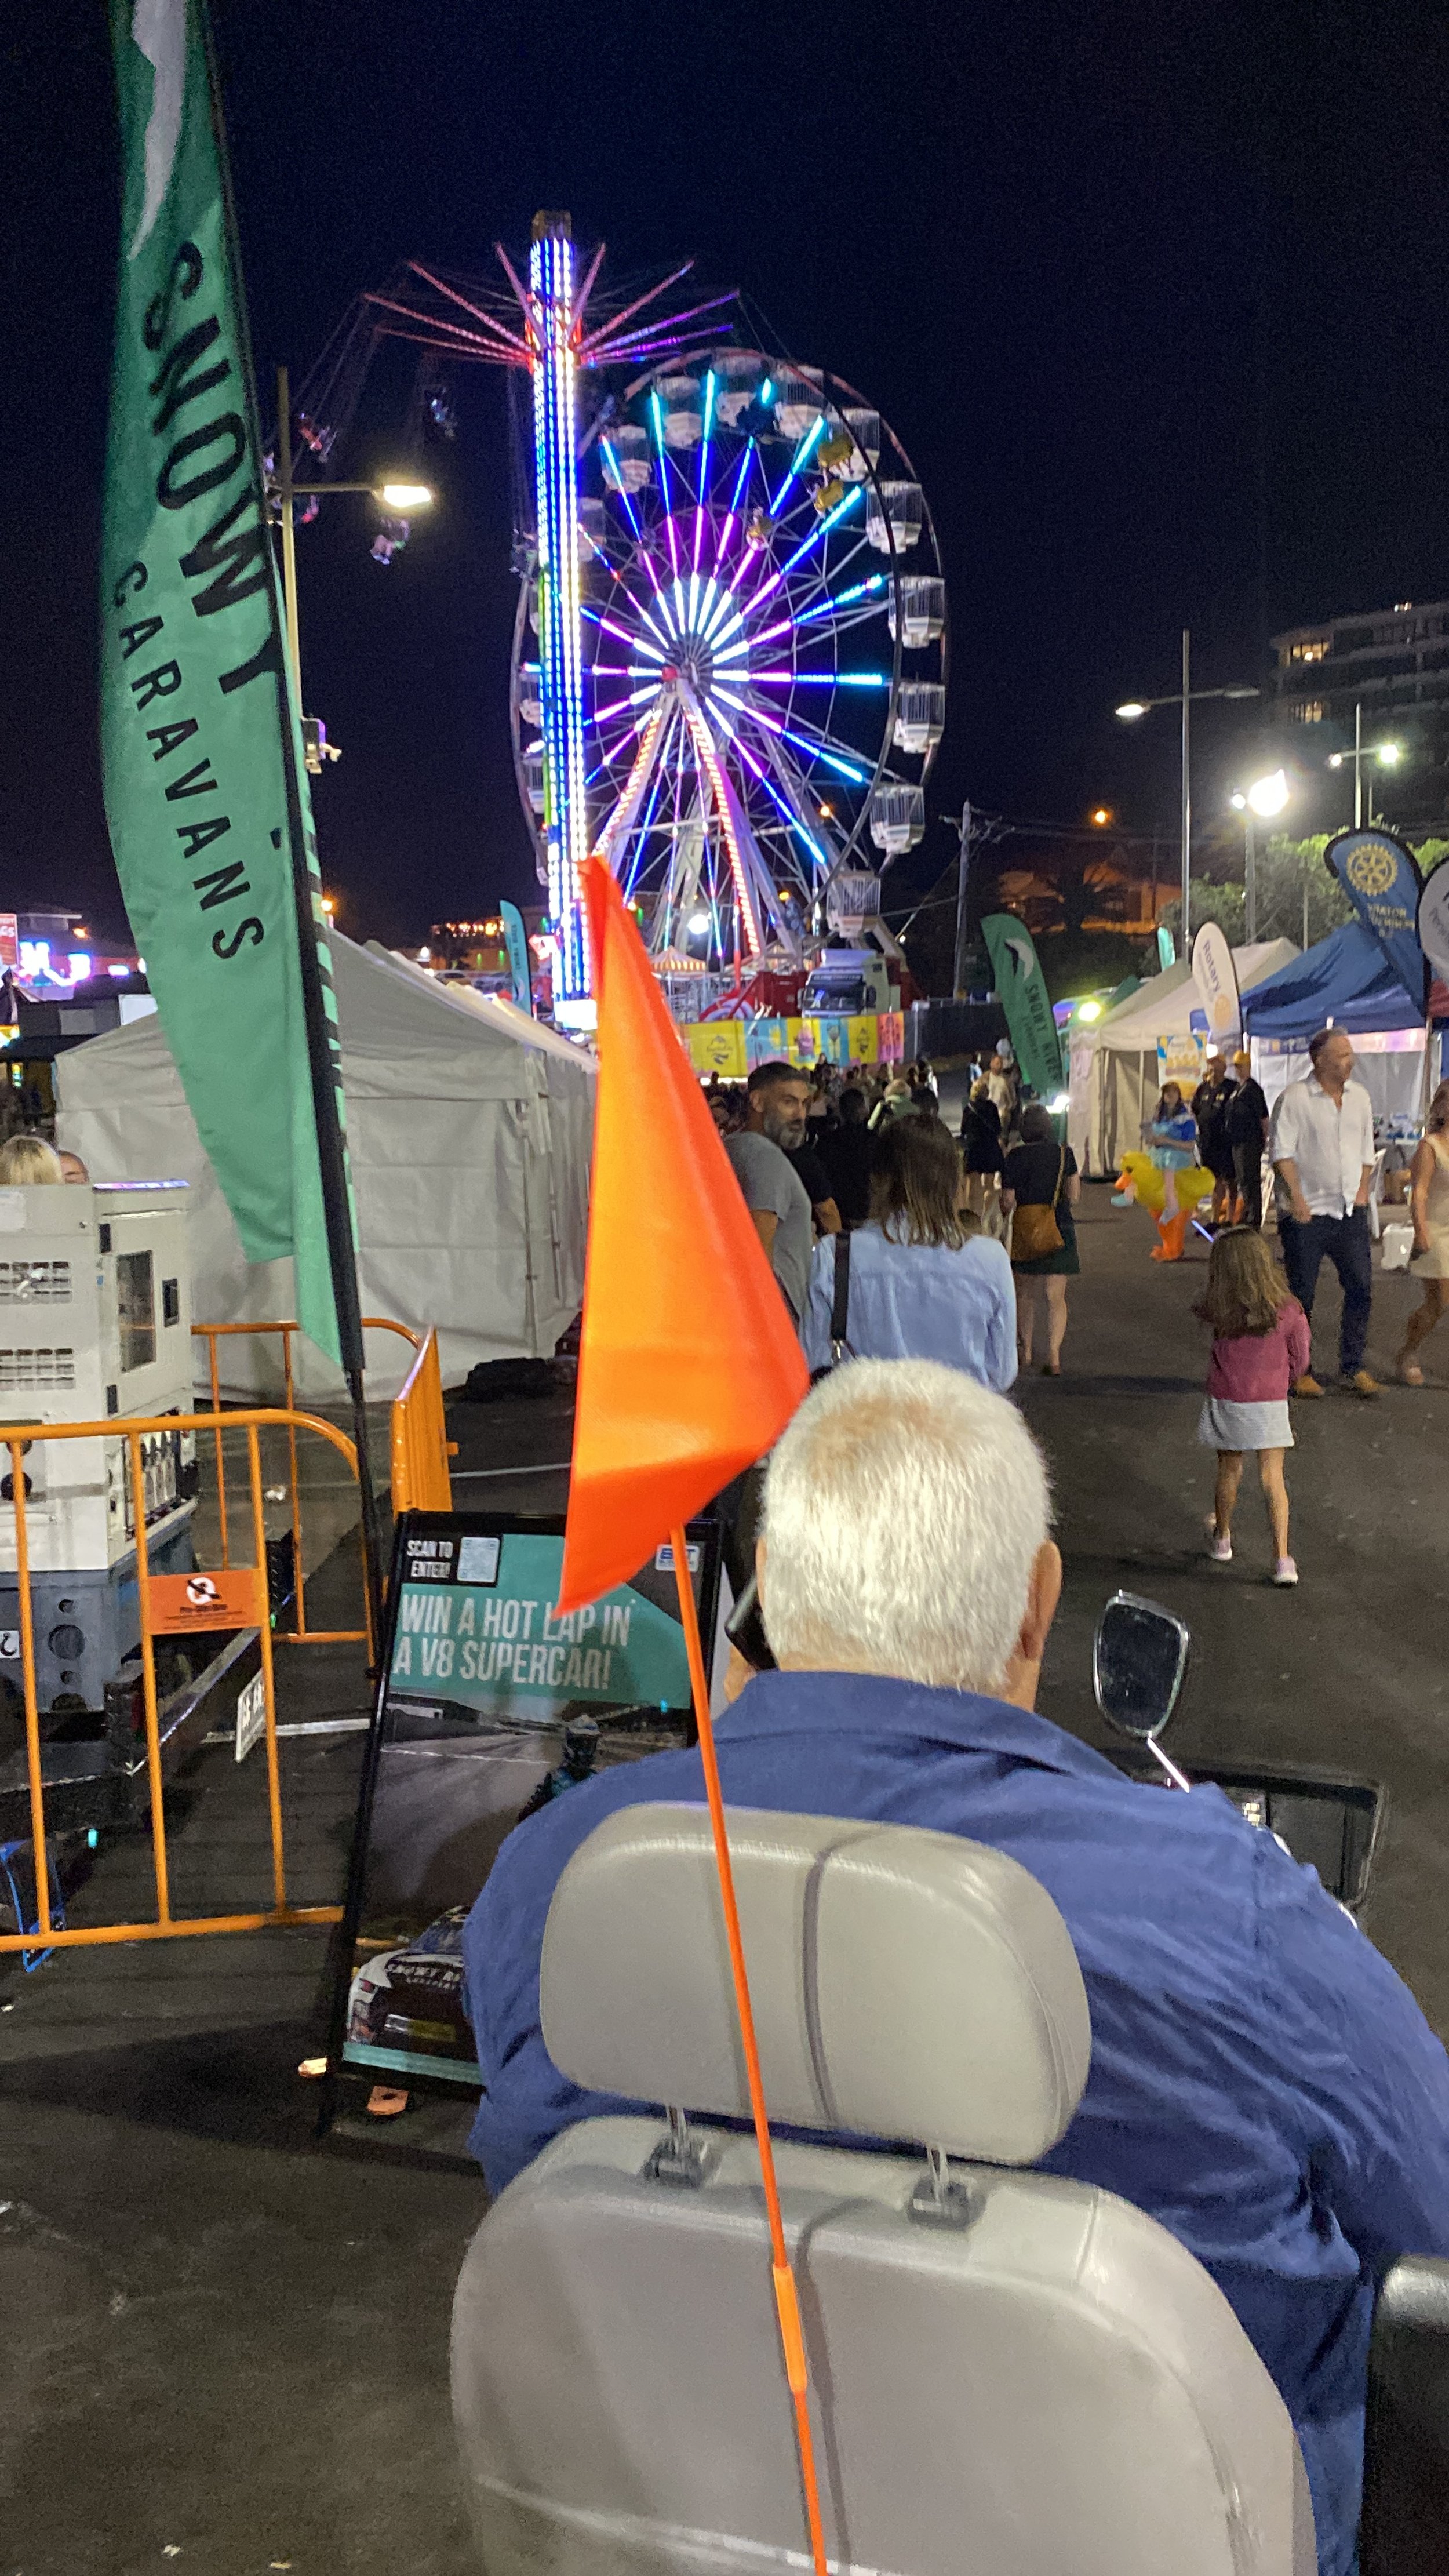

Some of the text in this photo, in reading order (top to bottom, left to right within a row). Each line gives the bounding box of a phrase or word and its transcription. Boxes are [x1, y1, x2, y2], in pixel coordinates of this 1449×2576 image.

[143, 241, 279, 694] SNOWY
[116, 560, 265, 959] CARAVANS
[1202, 939, 1221, 993] Rotary
[406, 1540, 438, 1558] SCAN
[402, 1594, 632, 1647] WIN A HOT LAP IN
[392, 1636, 612, 1690] A V8 SUPERCAR!
